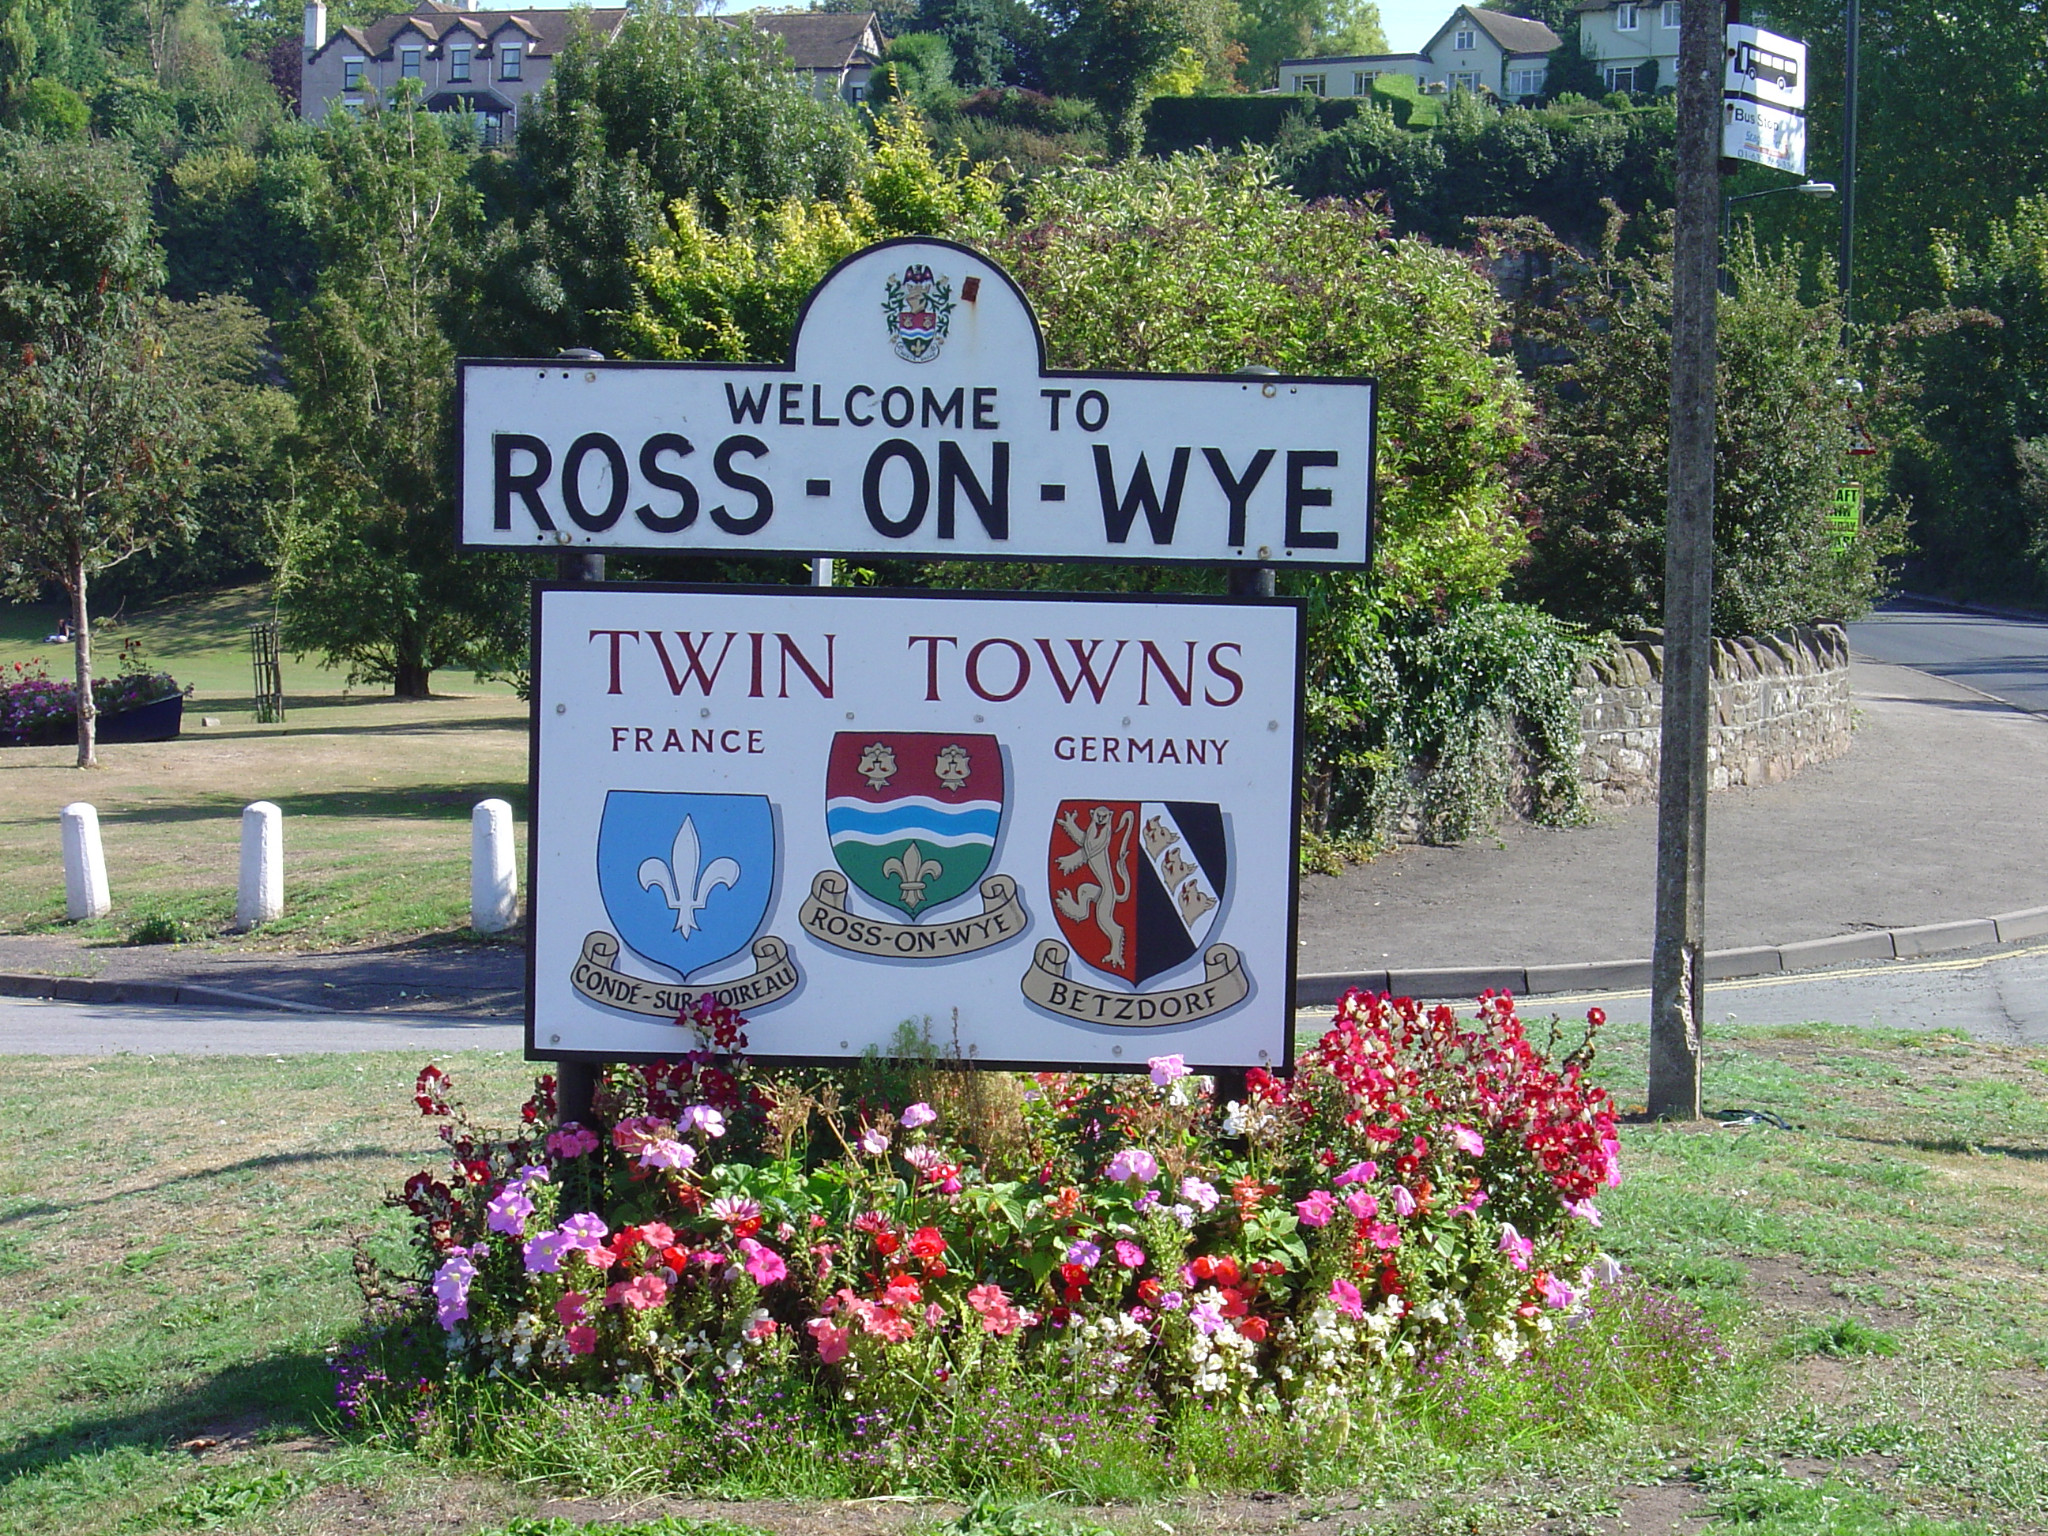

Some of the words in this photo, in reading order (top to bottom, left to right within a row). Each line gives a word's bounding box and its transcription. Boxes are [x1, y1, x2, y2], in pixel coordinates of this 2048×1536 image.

[1735, 109, 1756, 125] Bus
[725, 382, 998, 430] WELCOME
[1040, 389, 1109, 432] TO
[492, 433, 774, 534] ROSS
[862, 438, 1010, 541] ON
[1093, 444, 1340, 549] WYE
[588, 630, 837, 699] TWIN
[907, 636, 1245, 708] TOWNS
[610, 726, 766, 754] FRANCE
[1053, 736, 1230, 766] GERMANY
[808, 907, 1011, 952] ROSS-ON-WYE
[1048, 982, 1217, 1021] BETZDORF
